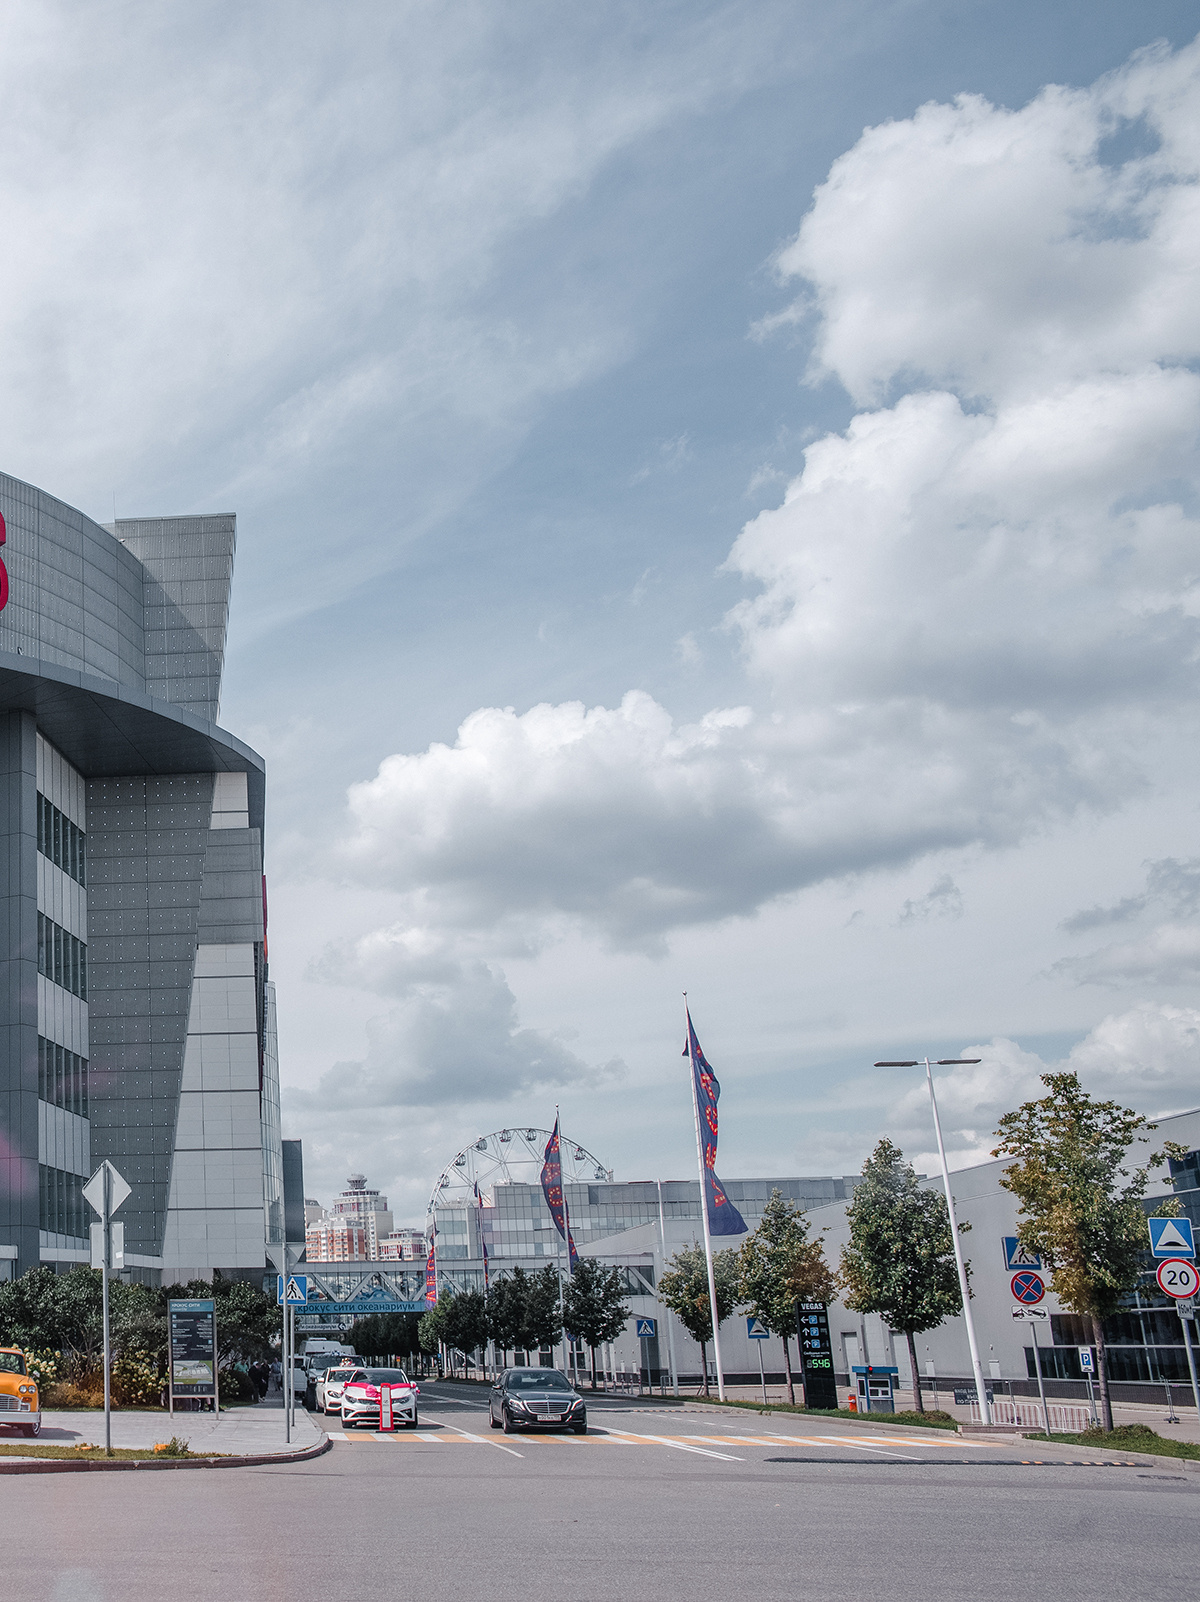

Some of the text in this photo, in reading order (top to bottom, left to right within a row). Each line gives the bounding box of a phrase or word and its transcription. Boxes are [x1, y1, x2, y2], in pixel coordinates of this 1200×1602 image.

[1166, 1270, 1190, 1286] 20
[297, 1301, 415, 1314] крокус сити океанариум
[801, 1302, 823, 1310] VEGAS
[812, 1358, 831, 1368] 546
